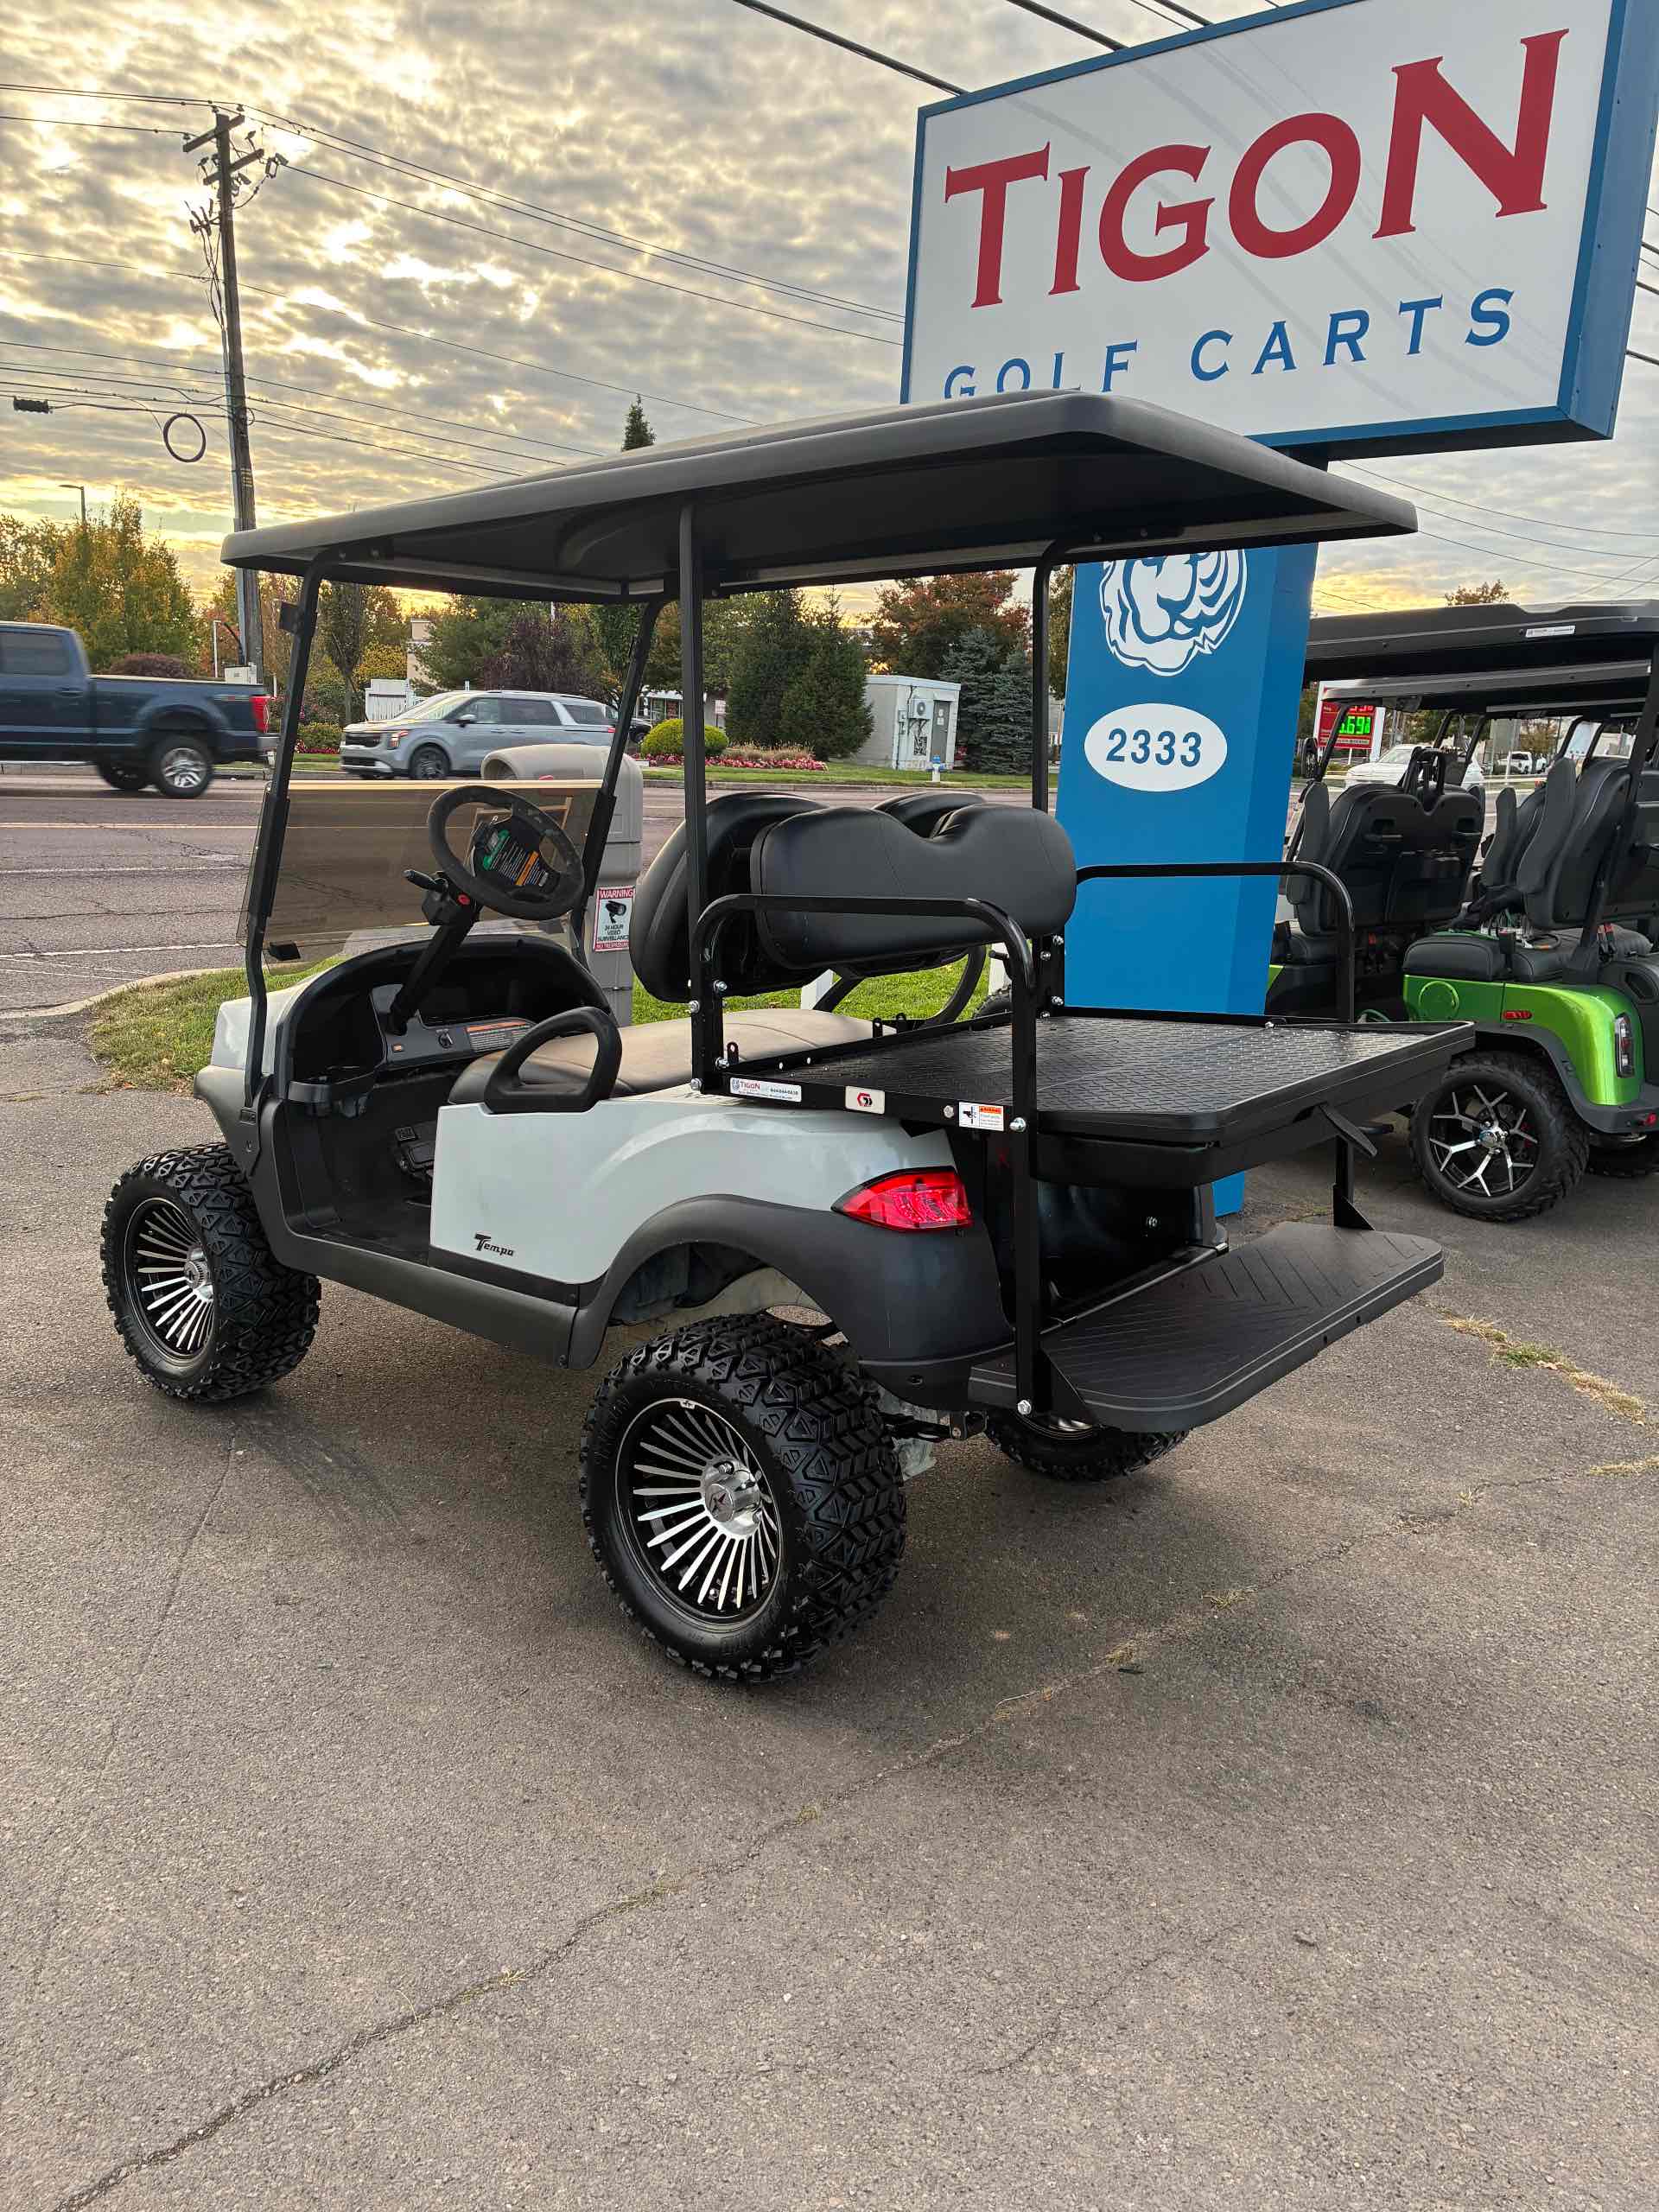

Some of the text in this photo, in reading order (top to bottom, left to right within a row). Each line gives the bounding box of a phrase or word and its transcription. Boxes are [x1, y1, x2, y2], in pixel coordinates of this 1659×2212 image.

[944, 30, 1568, 308] TIGON
[944, 288, 1514, 398] GOLF CARTS
[1106, 728, 1202, 767] 2333
[600, 889, 633, 899] WARNING
[474, 1233, 515, 1257] Tempo
